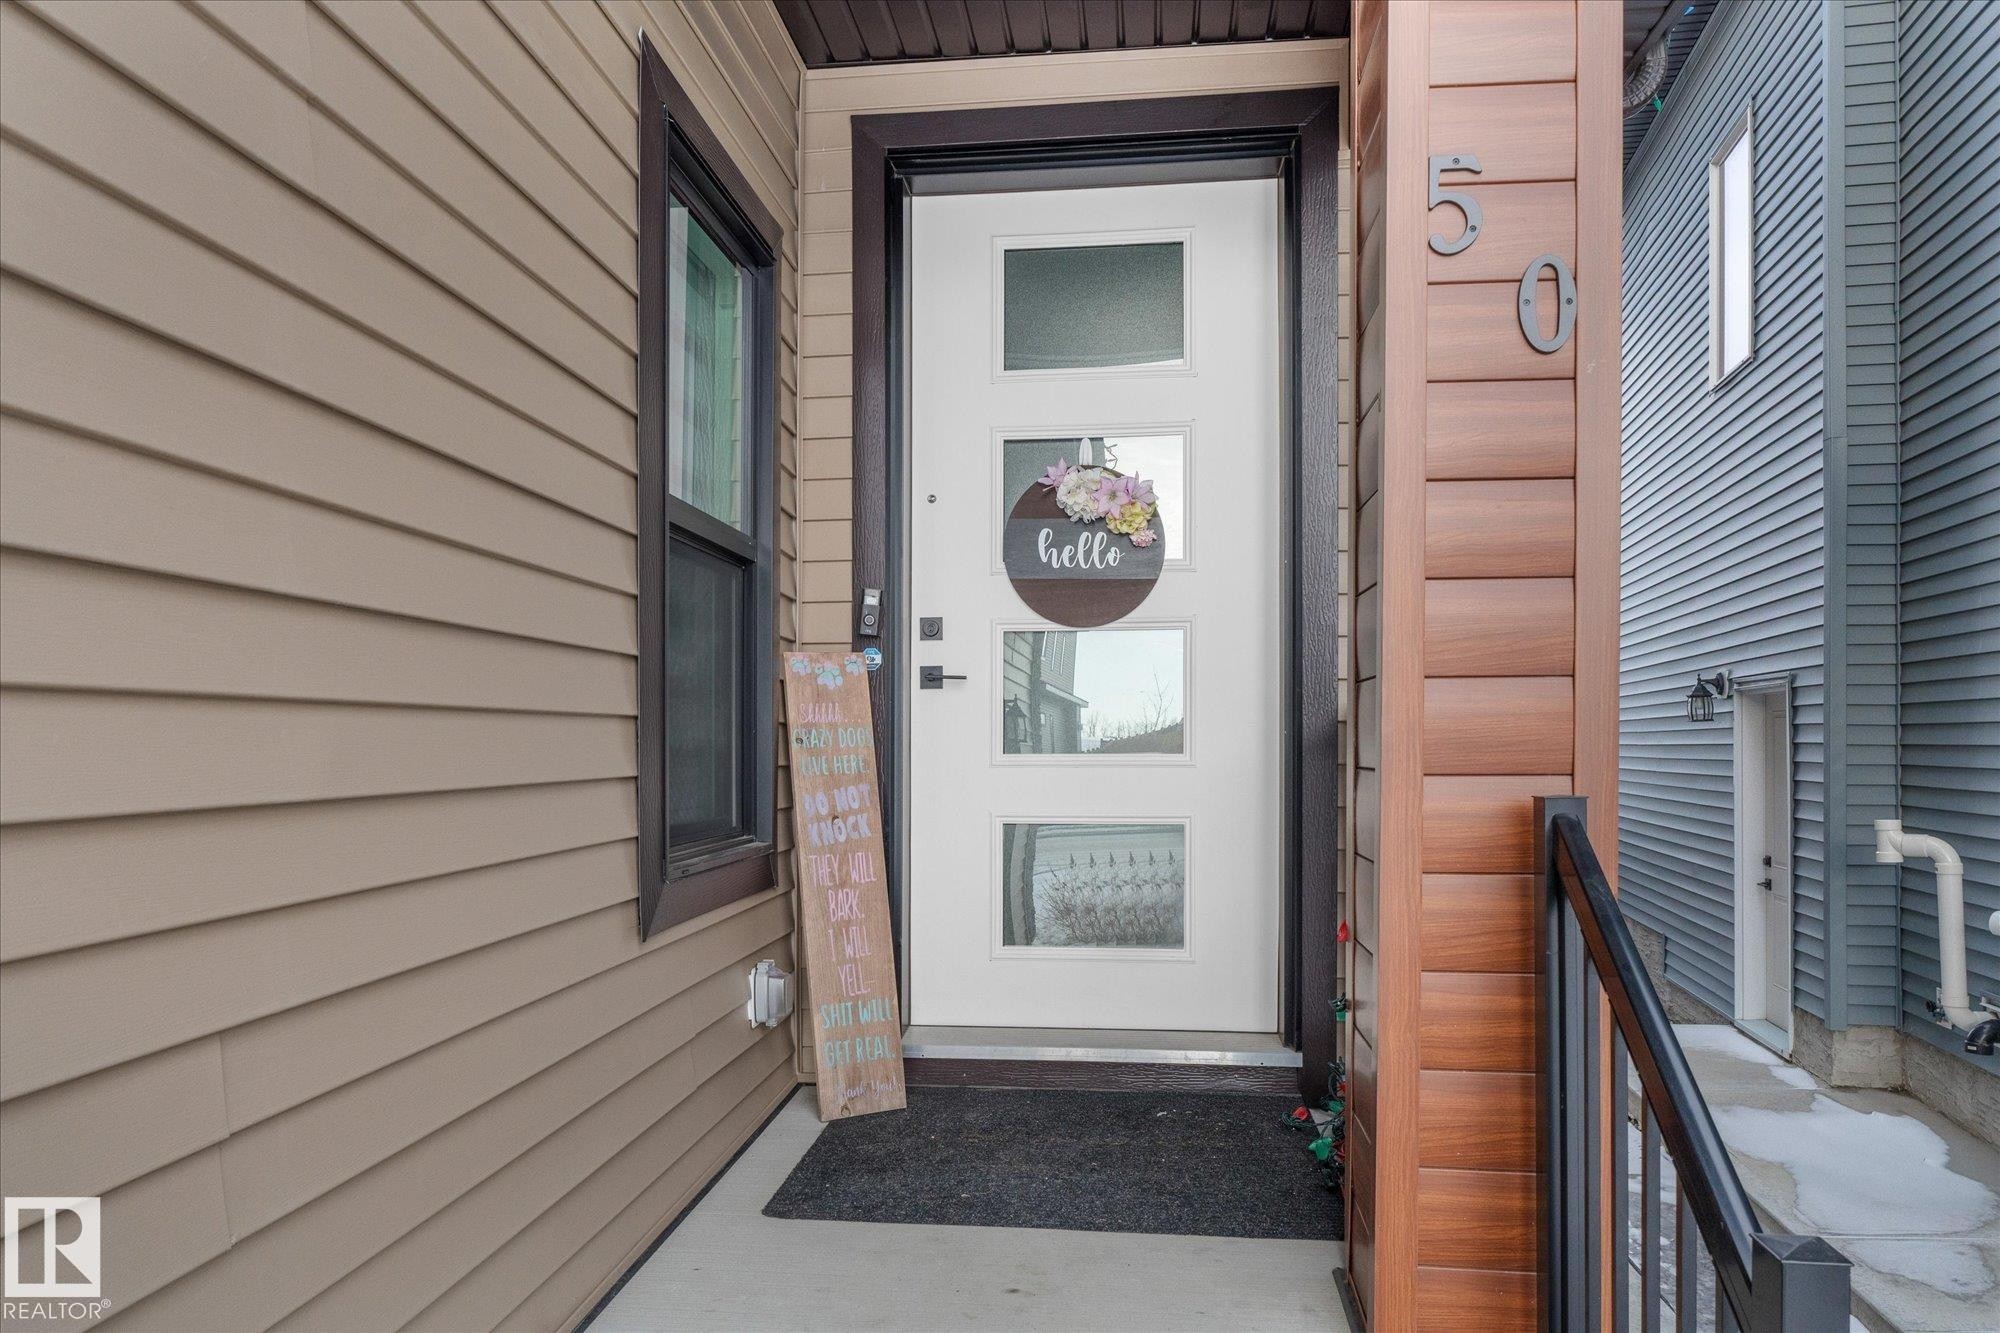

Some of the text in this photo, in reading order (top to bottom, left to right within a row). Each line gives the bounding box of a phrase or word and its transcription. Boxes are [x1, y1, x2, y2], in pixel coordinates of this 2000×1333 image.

[1038, 527, 1125, 569] hello
[793, 728, 833, 749] CRAZY
[801, 755, 829, 775] LIVE
[803, 784, 871, 817] DO NOT
[808, 813, 872, 848] KNOCK
[809, 851, 877, 887] THEY WILL
[828, 889, 865, 922] BARK.
[828, 926, 871, 961] I WILL
[820, 997, 893, 1029] SHIT WILL
[823, 1039, 850, 1068] GET
